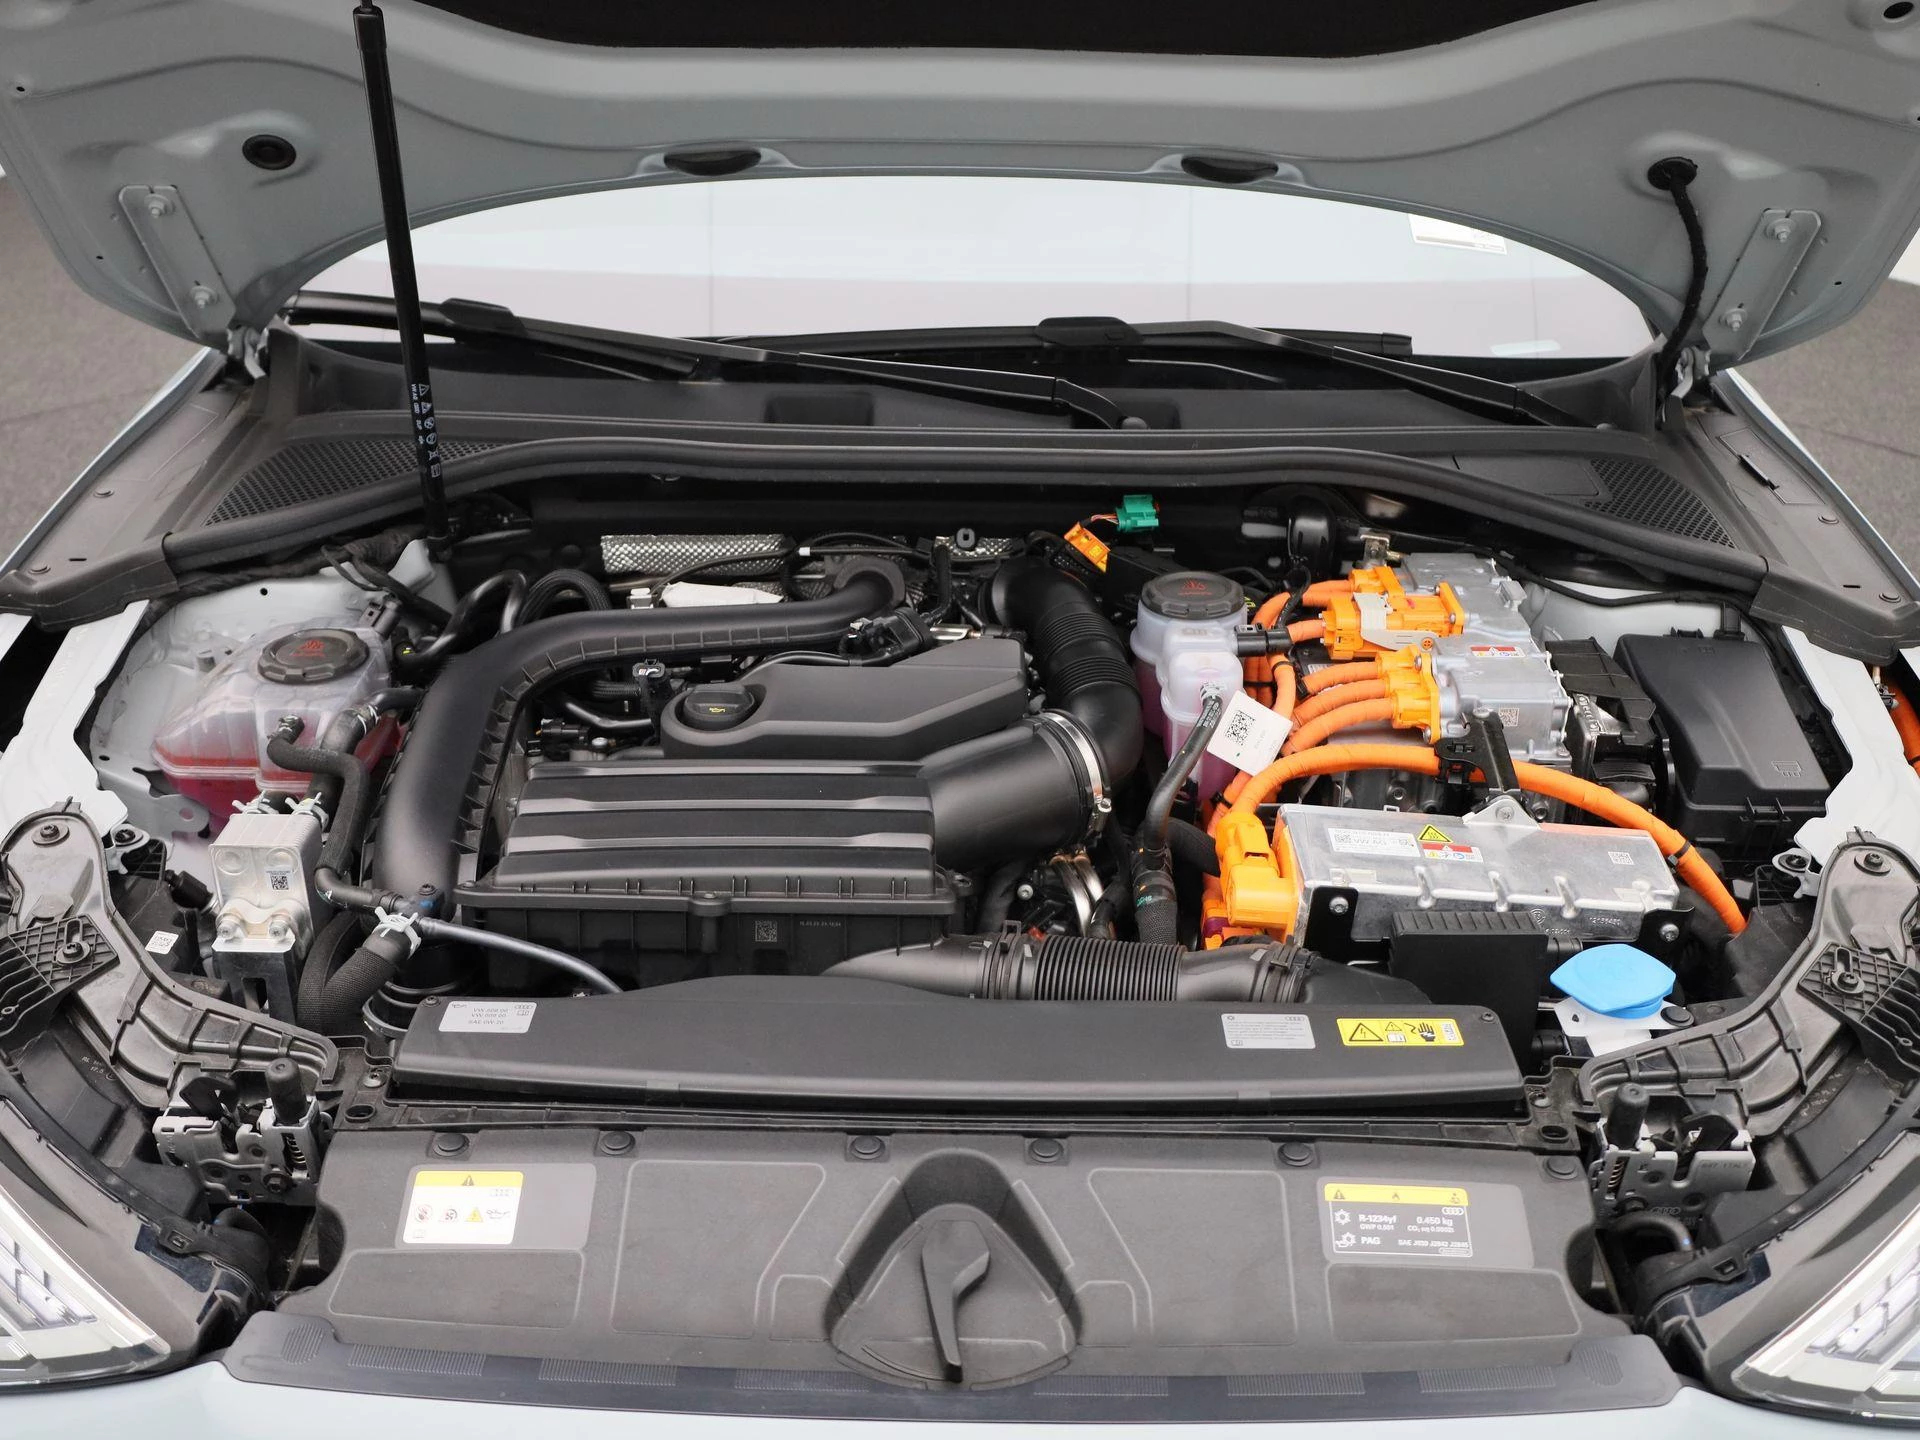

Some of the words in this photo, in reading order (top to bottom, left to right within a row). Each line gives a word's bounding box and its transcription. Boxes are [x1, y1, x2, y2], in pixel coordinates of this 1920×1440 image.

[1358, 1214, 1397, 1224] R-1234yf
[1442, 1217, 1453, 1227] kg
[1361, 1236, 1381, 1245] PAG
